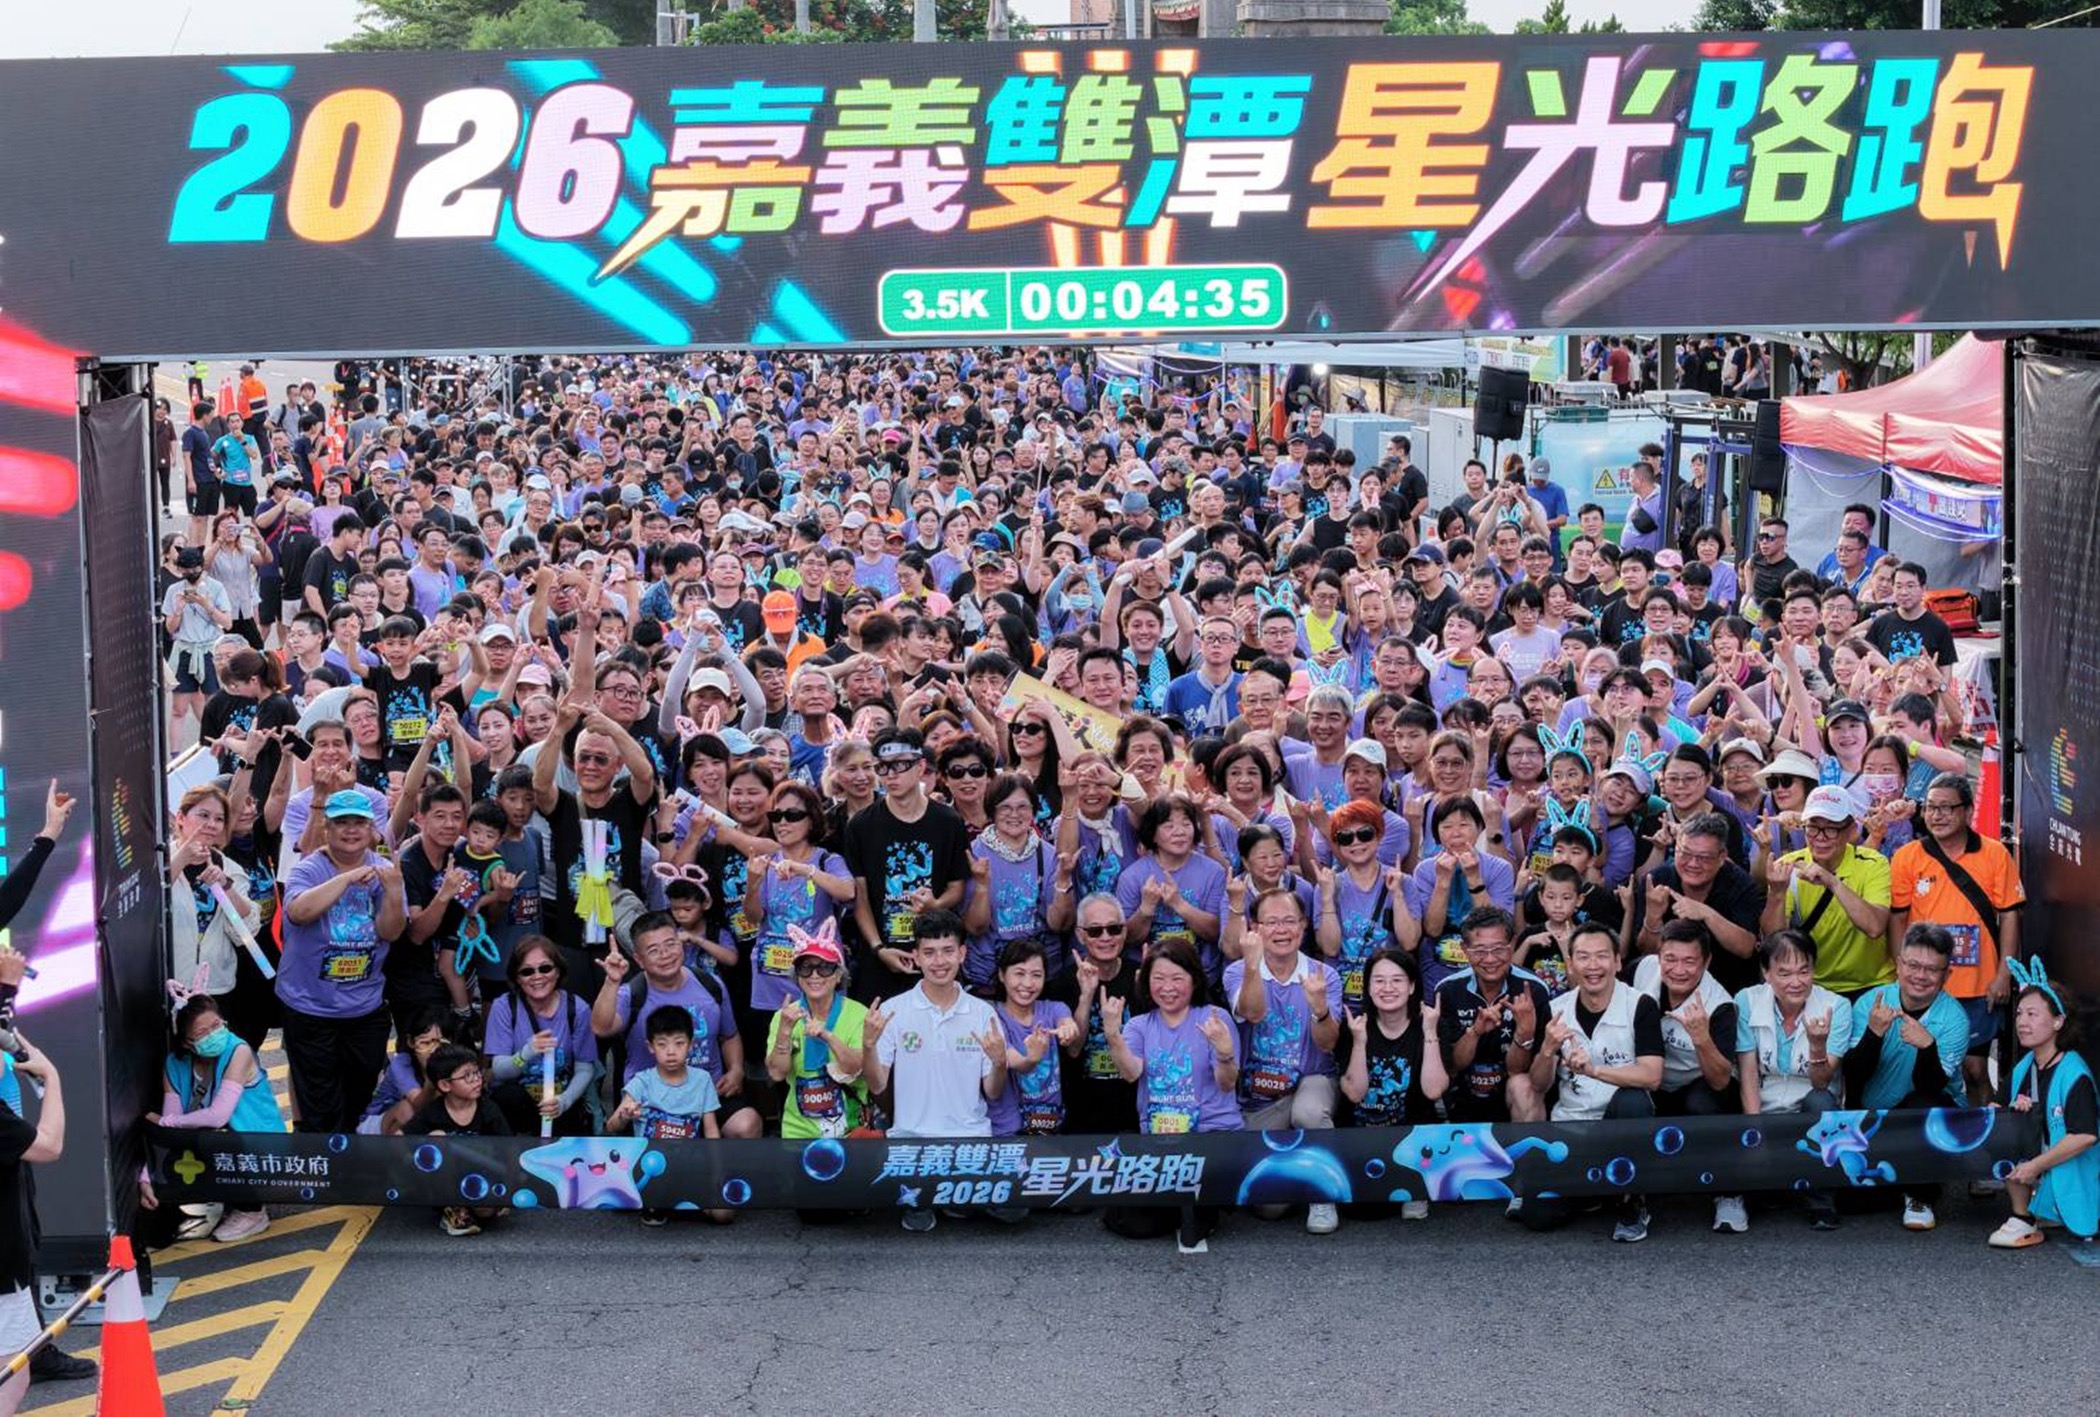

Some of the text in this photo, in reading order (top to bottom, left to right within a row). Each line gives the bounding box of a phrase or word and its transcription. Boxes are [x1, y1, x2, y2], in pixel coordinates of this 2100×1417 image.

[902, 287, 989, 320] 3.5K
[1020, 279, 1271, 321] 00:04:35
[1254, 1077, 1286, 1091] 90028
[213, 1152, 330, 1176] 嘉義市政府
[871, 1143, 1028, 1184] 嘉義雙潭
[247, 1178, 269, 1186] CITY
[270, 1179, 331, 1188] GOVERNMENT
[932, 1180, 1013, 1205] 2026
[1021, 1154, 1206, 1207] 星光路跑
